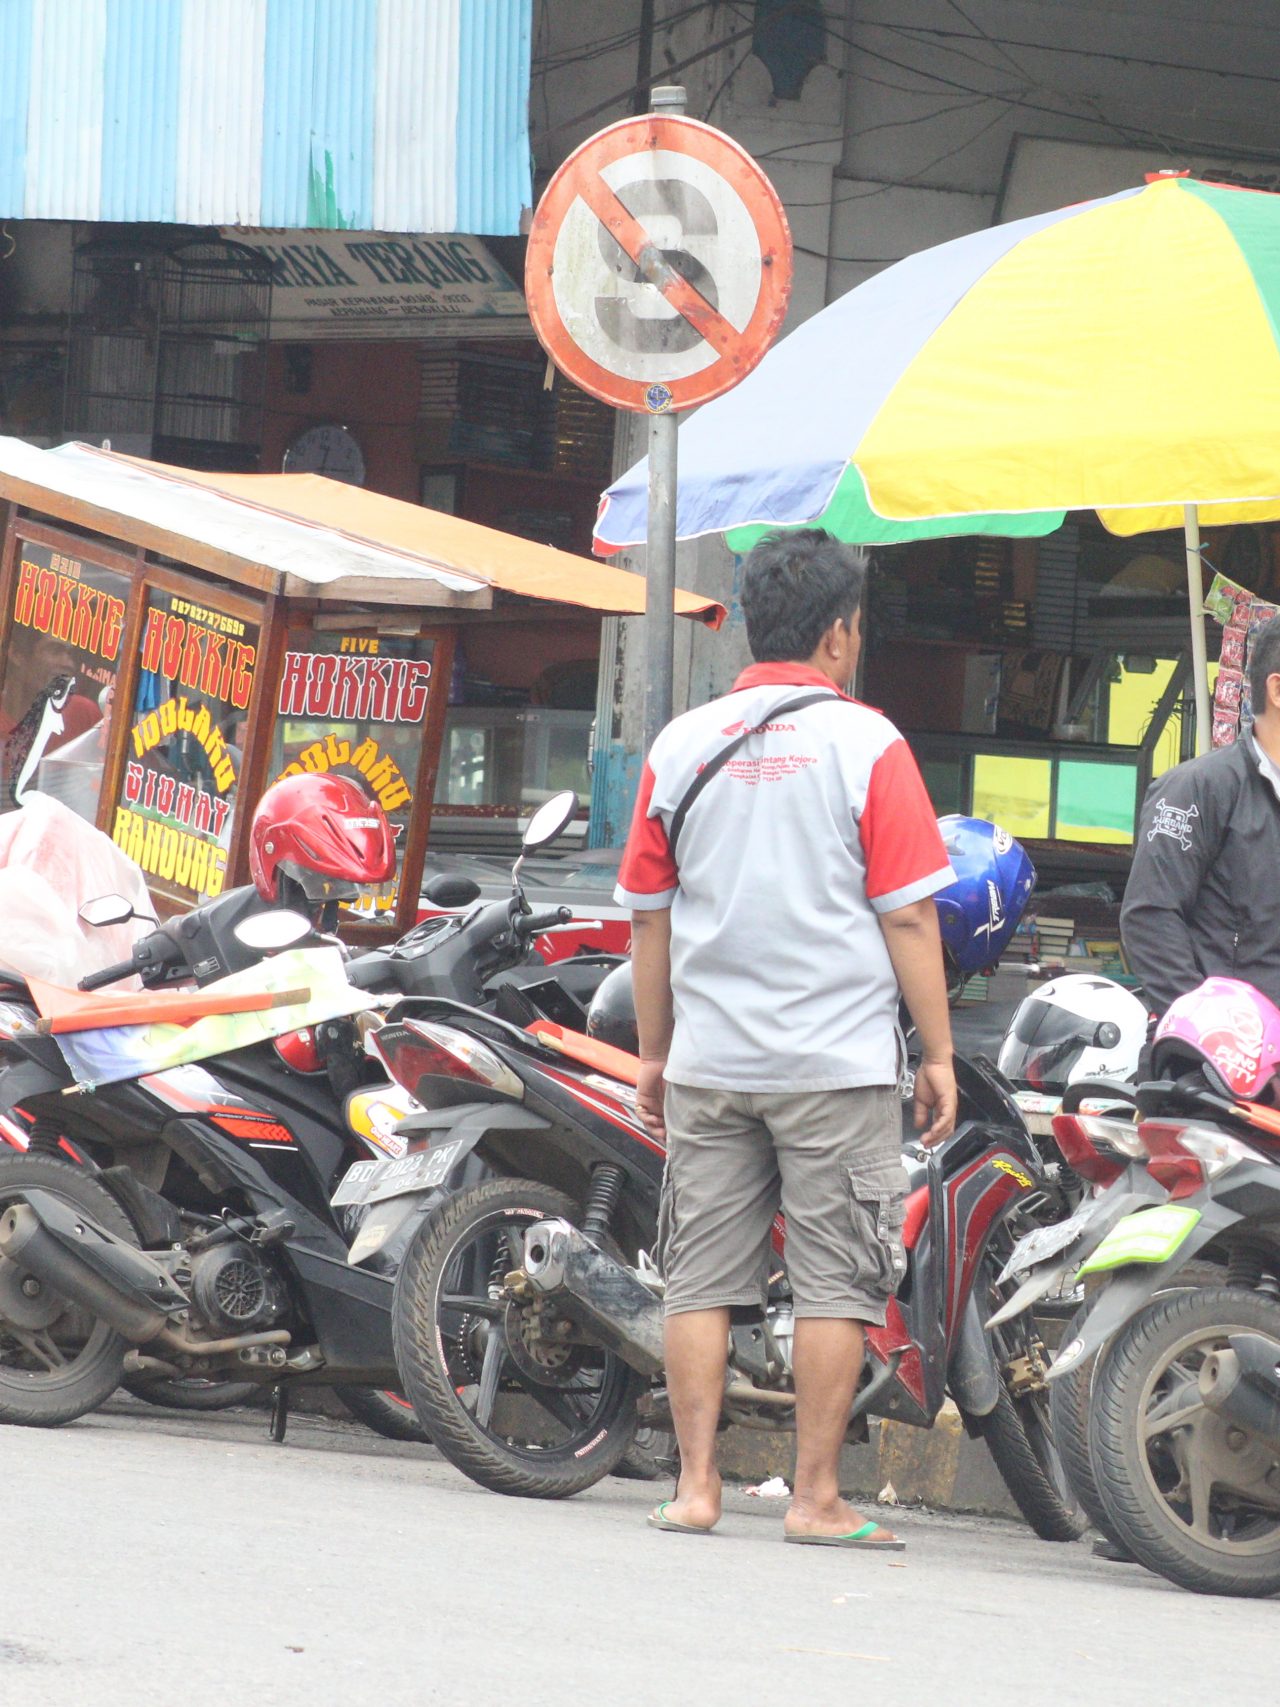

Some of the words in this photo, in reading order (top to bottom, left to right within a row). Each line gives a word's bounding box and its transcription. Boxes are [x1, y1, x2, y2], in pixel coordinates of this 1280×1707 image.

[345, 240, 494, 289] TERANG
[14, 560, 125, 662] HOKKIE
[340, 636, 379, 654] FIVE
[141, 606, 256, 710] HOKKIE
[279, 651, 432, 723] HOKKIE
[131, 697, 236, 793] IDOLAKU
[743, 723, 796, 735] HONDA
[124, 760, 230, 838] SIOMAY
[380, 1153, 425, 1181] 2023
[427, 1145, 456, 1167] PK
